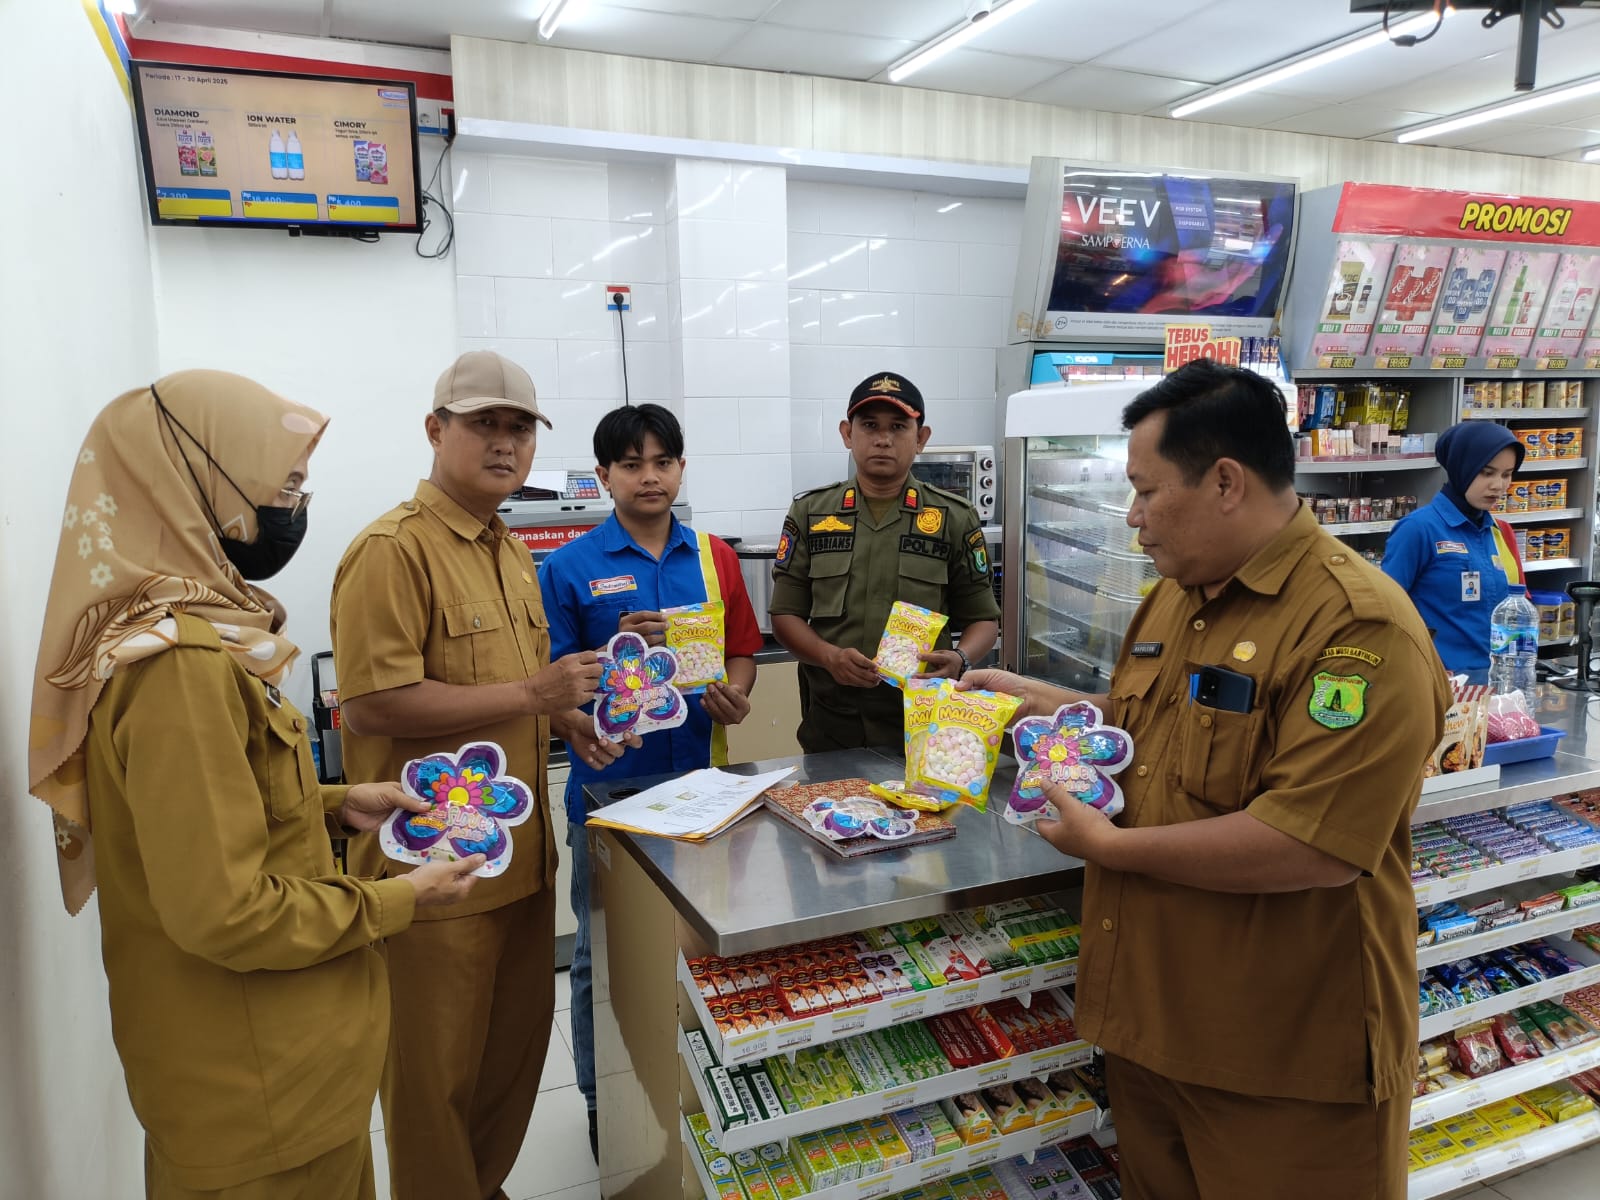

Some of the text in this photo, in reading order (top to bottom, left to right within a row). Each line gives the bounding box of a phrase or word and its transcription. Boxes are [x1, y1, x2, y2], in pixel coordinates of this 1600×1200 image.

[196, 77, 211, 85] April
[154, 108, 200, 118] DIAMOND
[247, 114, 296, 124] ION WATER
[334, 120, 366, 129] CIMORY
[1076, 195, 1161, 228] VEEV
[1459, 201, 1573, 235] PROMOSI
[1346, 324, 1365, 333] GRATIS
[1167, 328, 1209, 344] TEBUS
[1167, 340, 1240, 369] HEBOH!
[511, 530, 564, 540] Panaskan
[902, 540, 948, 556] POL PP
[938, 704, 998, 732] MALLOW
